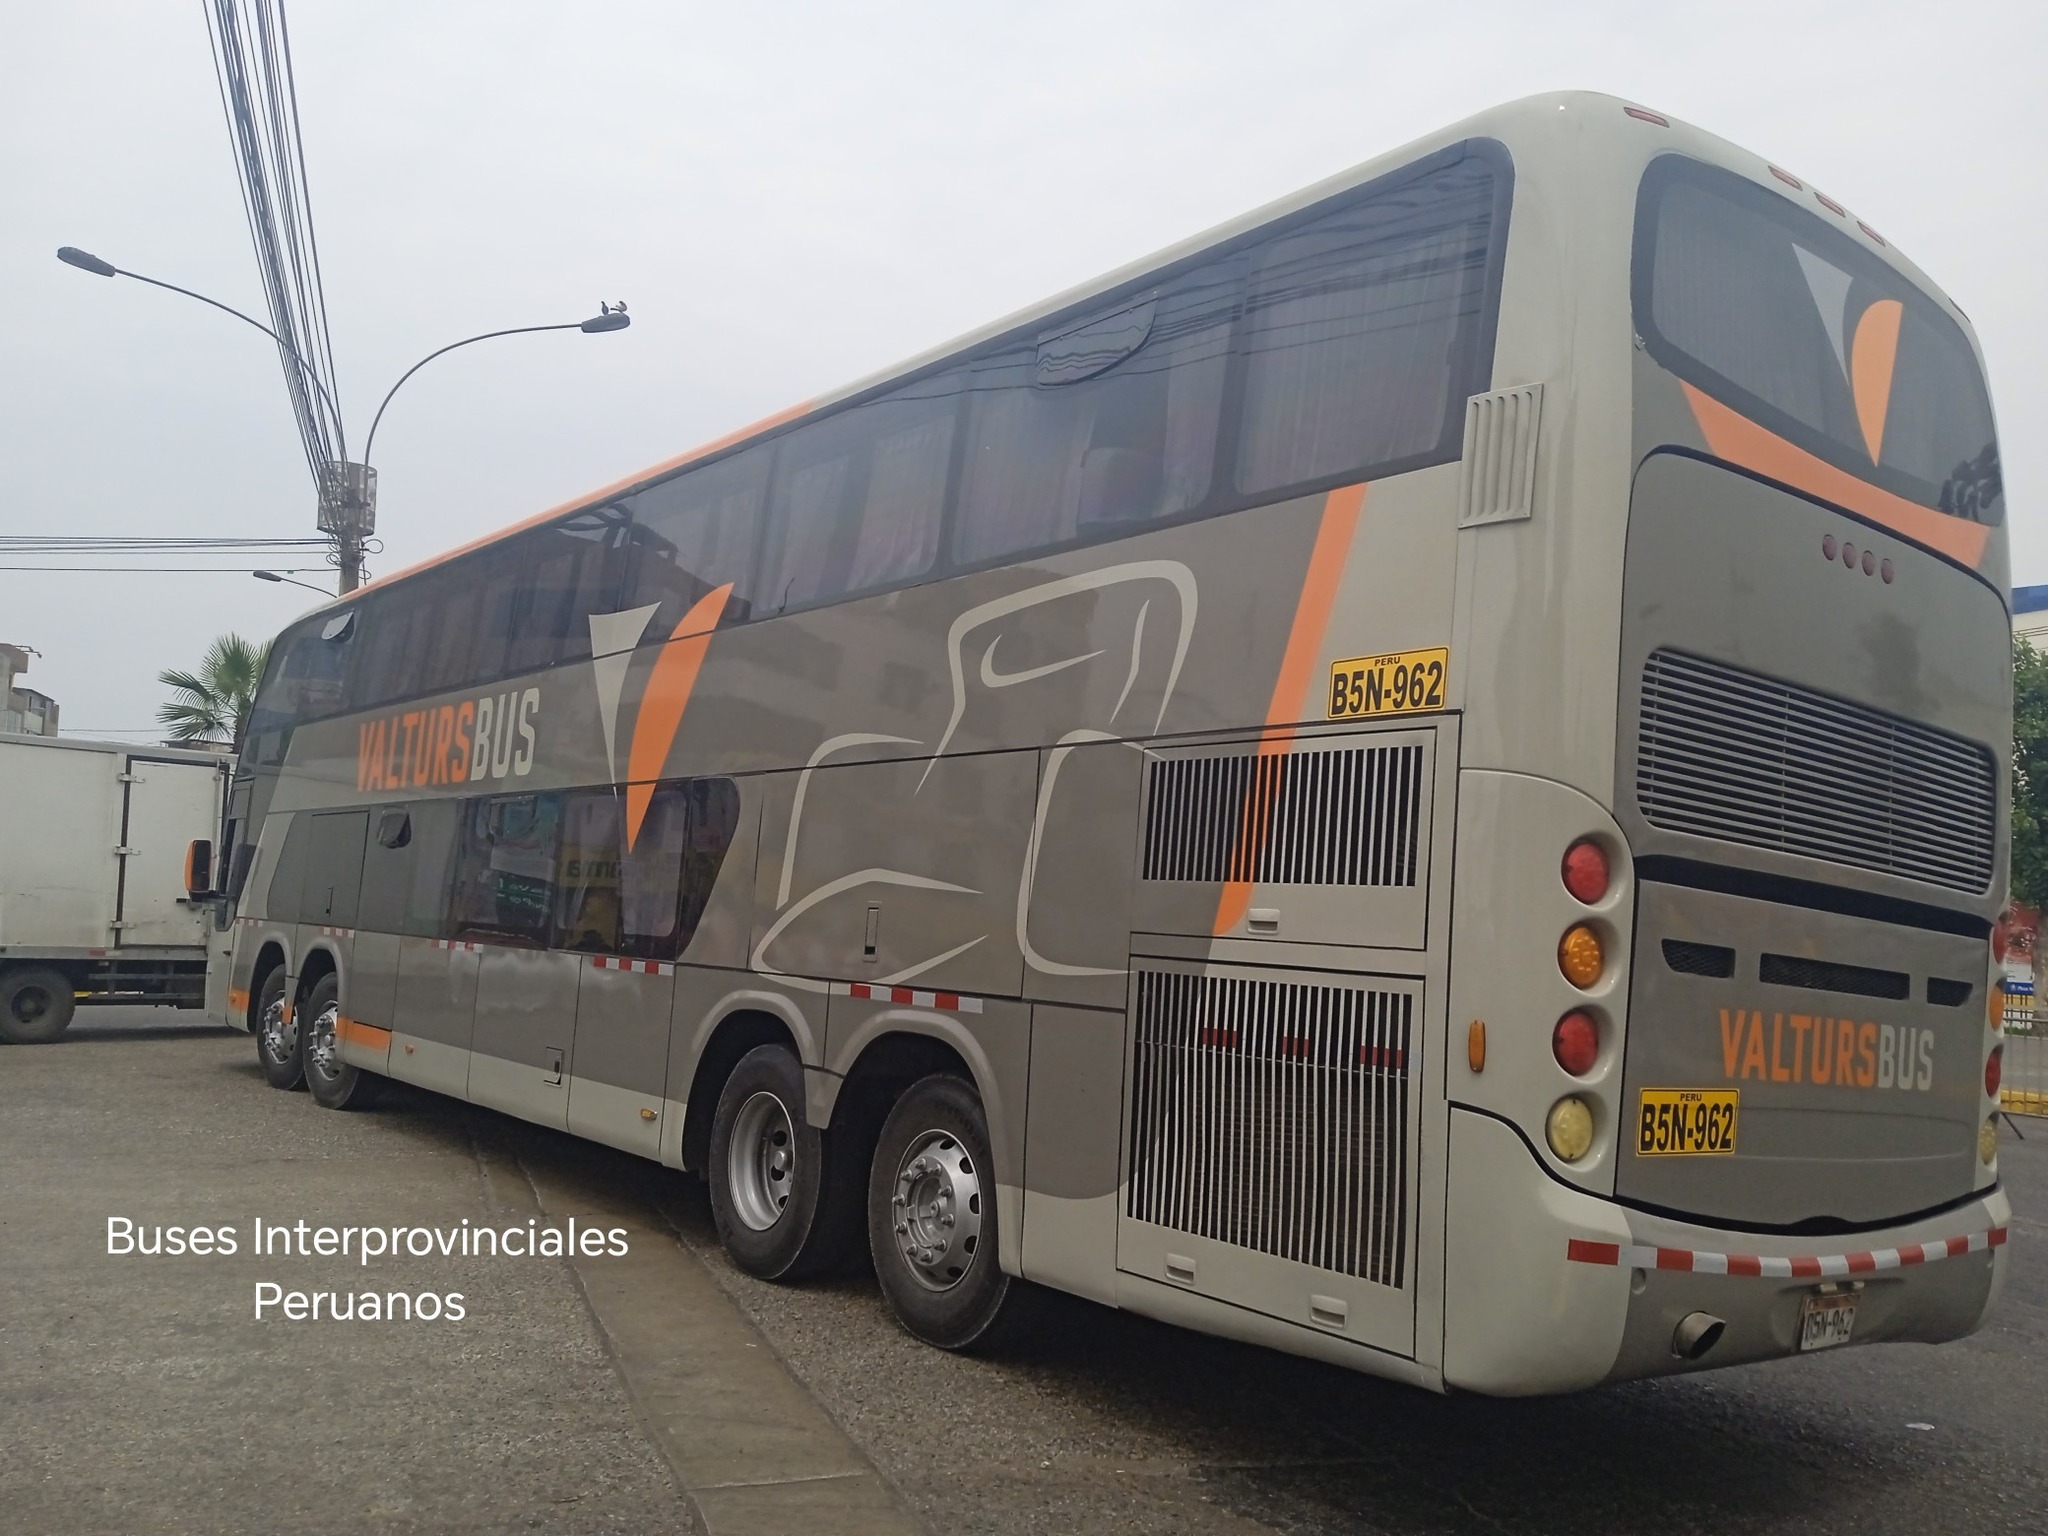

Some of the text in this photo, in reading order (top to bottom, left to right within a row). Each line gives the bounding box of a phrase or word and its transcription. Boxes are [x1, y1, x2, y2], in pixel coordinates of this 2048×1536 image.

[1374, 656, 1401, 667] PERU
[1331, 661, 1442, 715] B5N-962
[358, 688, 539, 791] VALTURSBUS
[1719, 1008, 1935, 1091] VALTURSBUS
[1680, 1093, 1703, 1102] PERU
[1641, 1103, 1734, 1152] B5N-962
